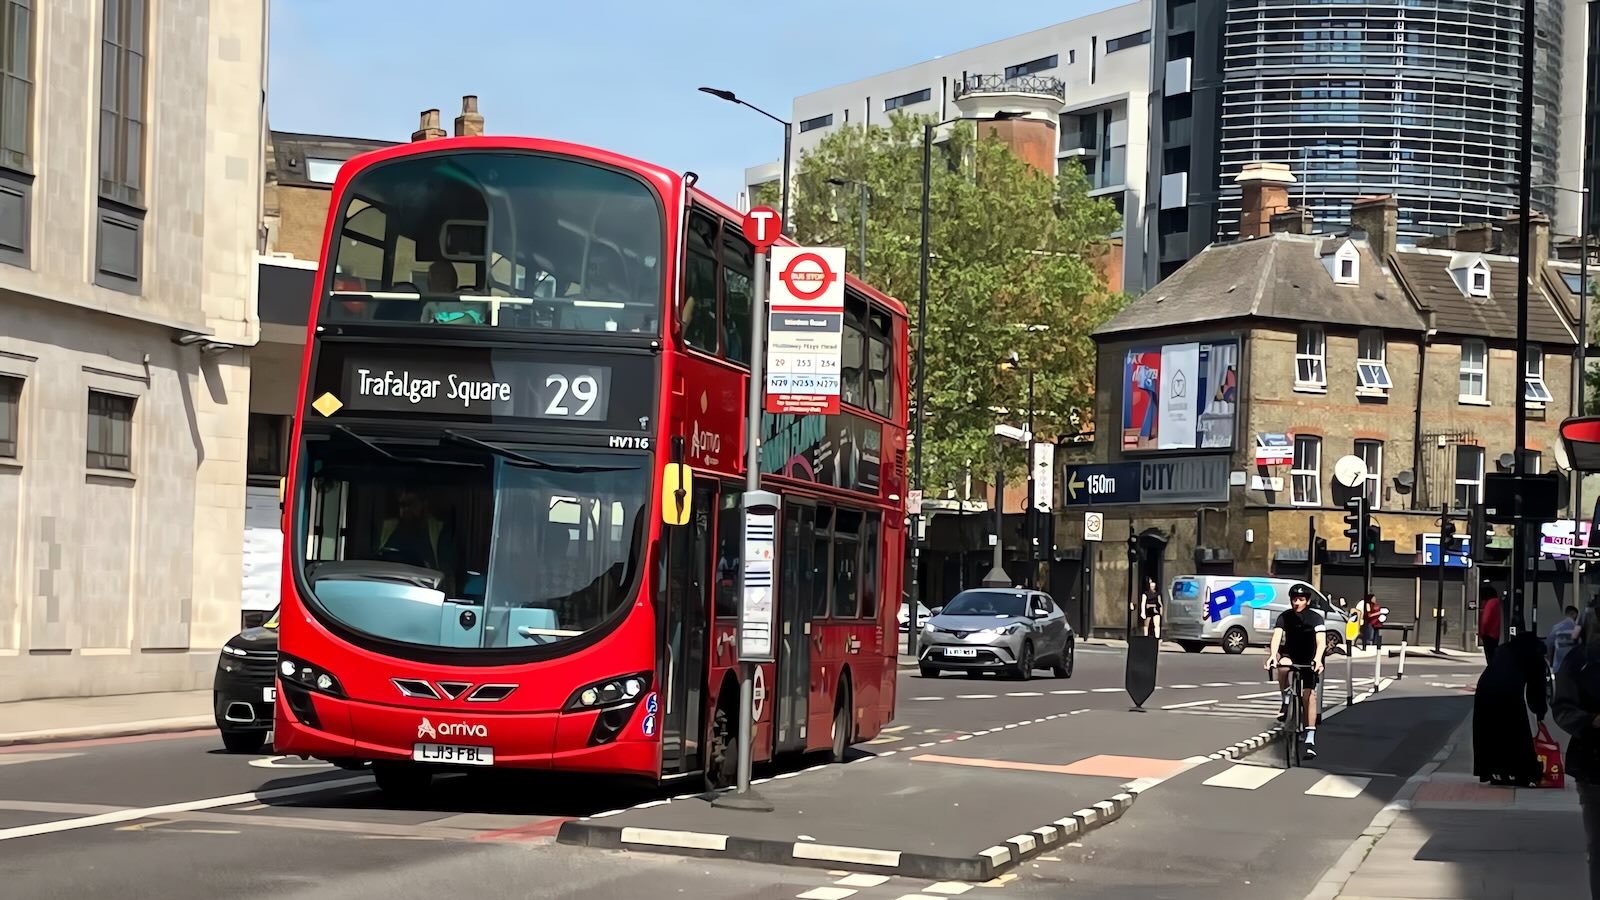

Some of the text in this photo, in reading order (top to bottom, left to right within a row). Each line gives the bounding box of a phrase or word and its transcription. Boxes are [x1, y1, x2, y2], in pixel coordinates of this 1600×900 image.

[751, 212, 773, 241] T
[791, 272, 825, 282] BUS STOP
[358, 369, 511, 407] Trafalgar Square
[544, 373, 598, 417] 29
[609, 435, 649, 449] HV116
[1087, 474, 1115, 494] 150m
[437, 721, 488, 737] arriva
[422, 745, 484, 762] LJ13 FBL
